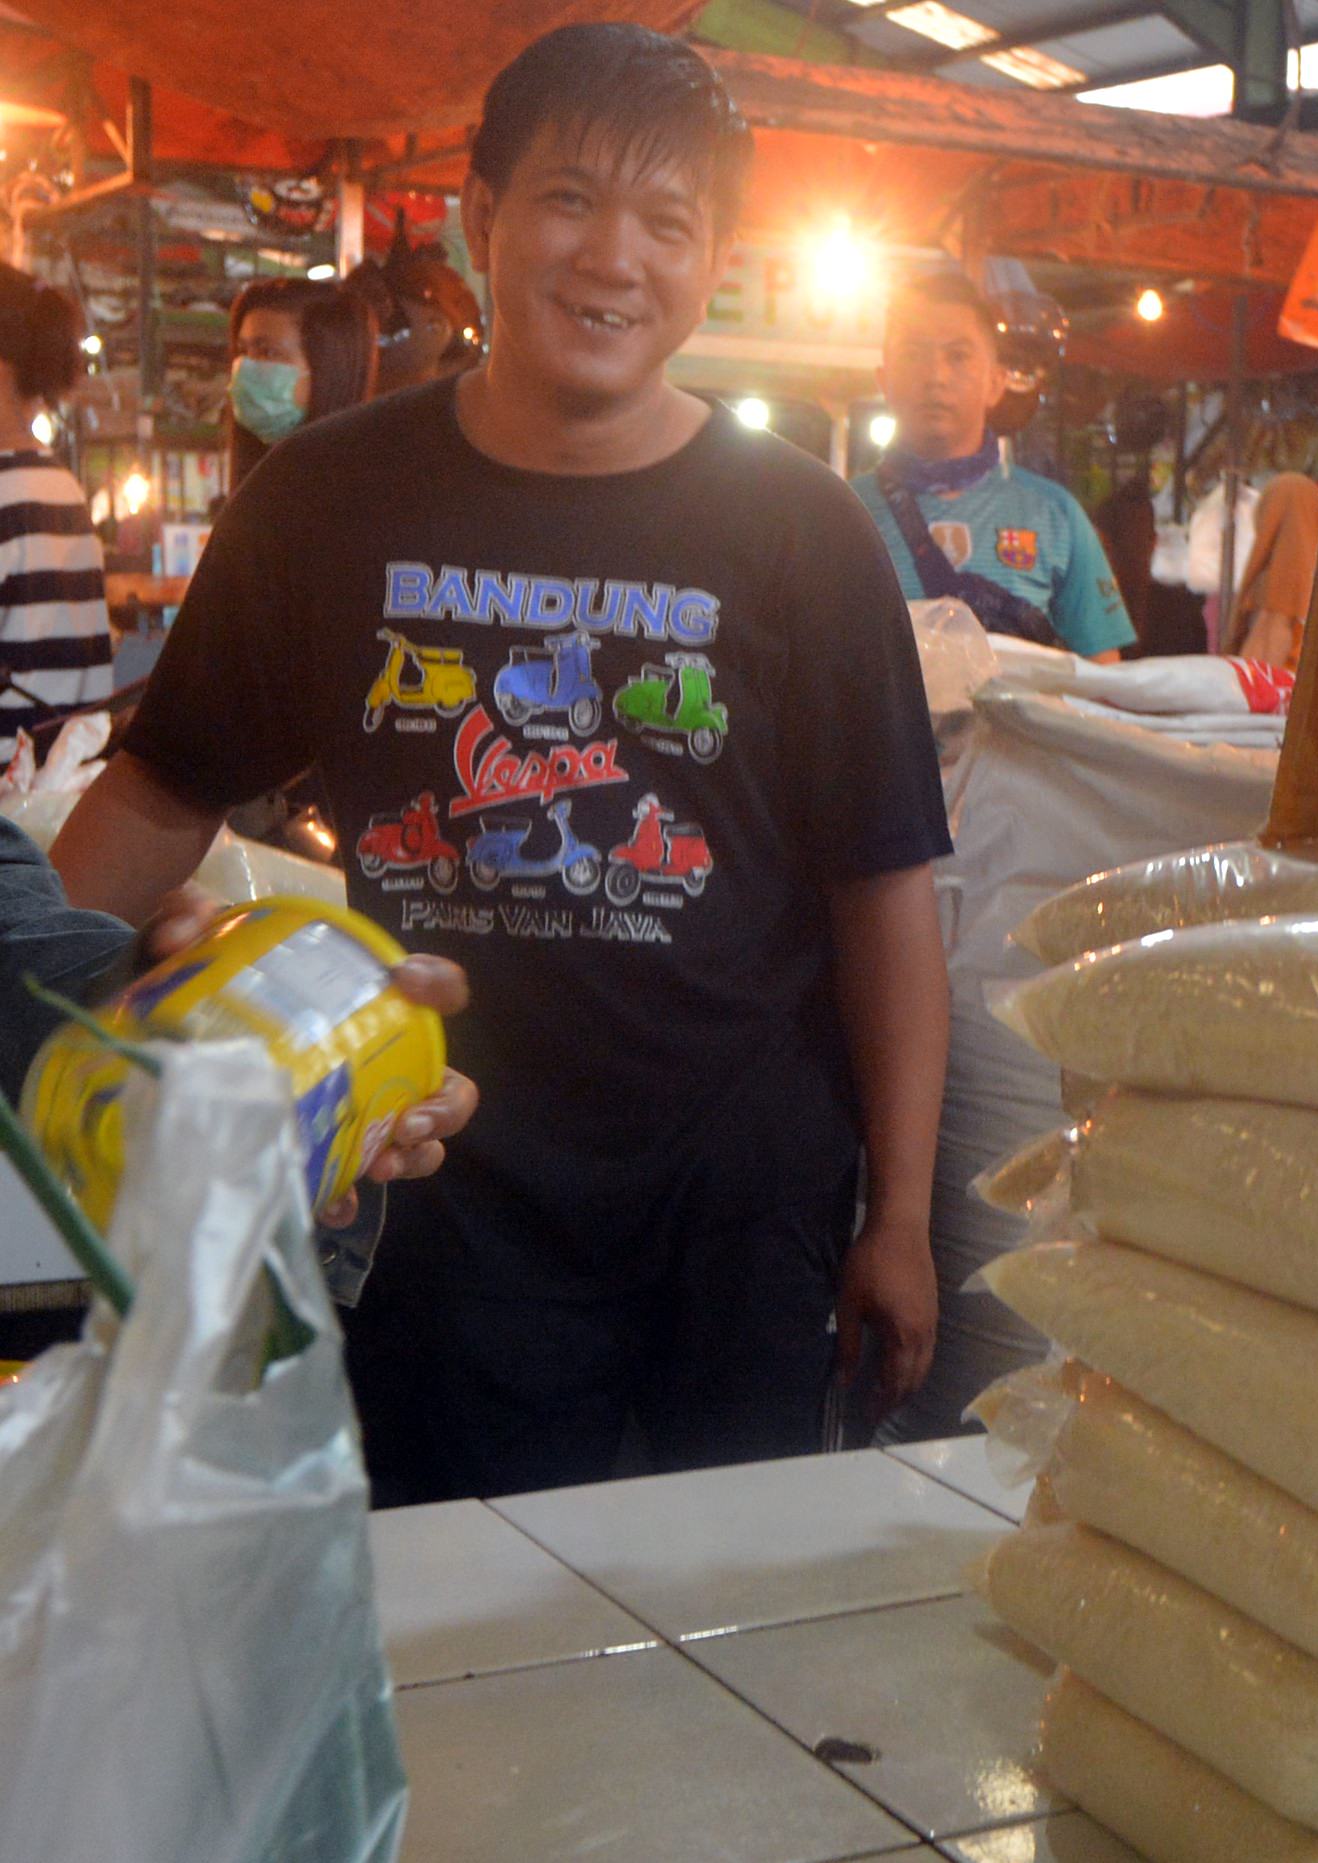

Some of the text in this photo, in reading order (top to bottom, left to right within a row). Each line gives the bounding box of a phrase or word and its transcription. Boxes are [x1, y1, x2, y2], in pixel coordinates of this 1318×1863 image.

[383, 561, 721, 647] BANDUNG
[449, 704, 629, 818] Vespa
[501, 904, 573, 939] VAN
[580, 906, 672, 944] JAVA
